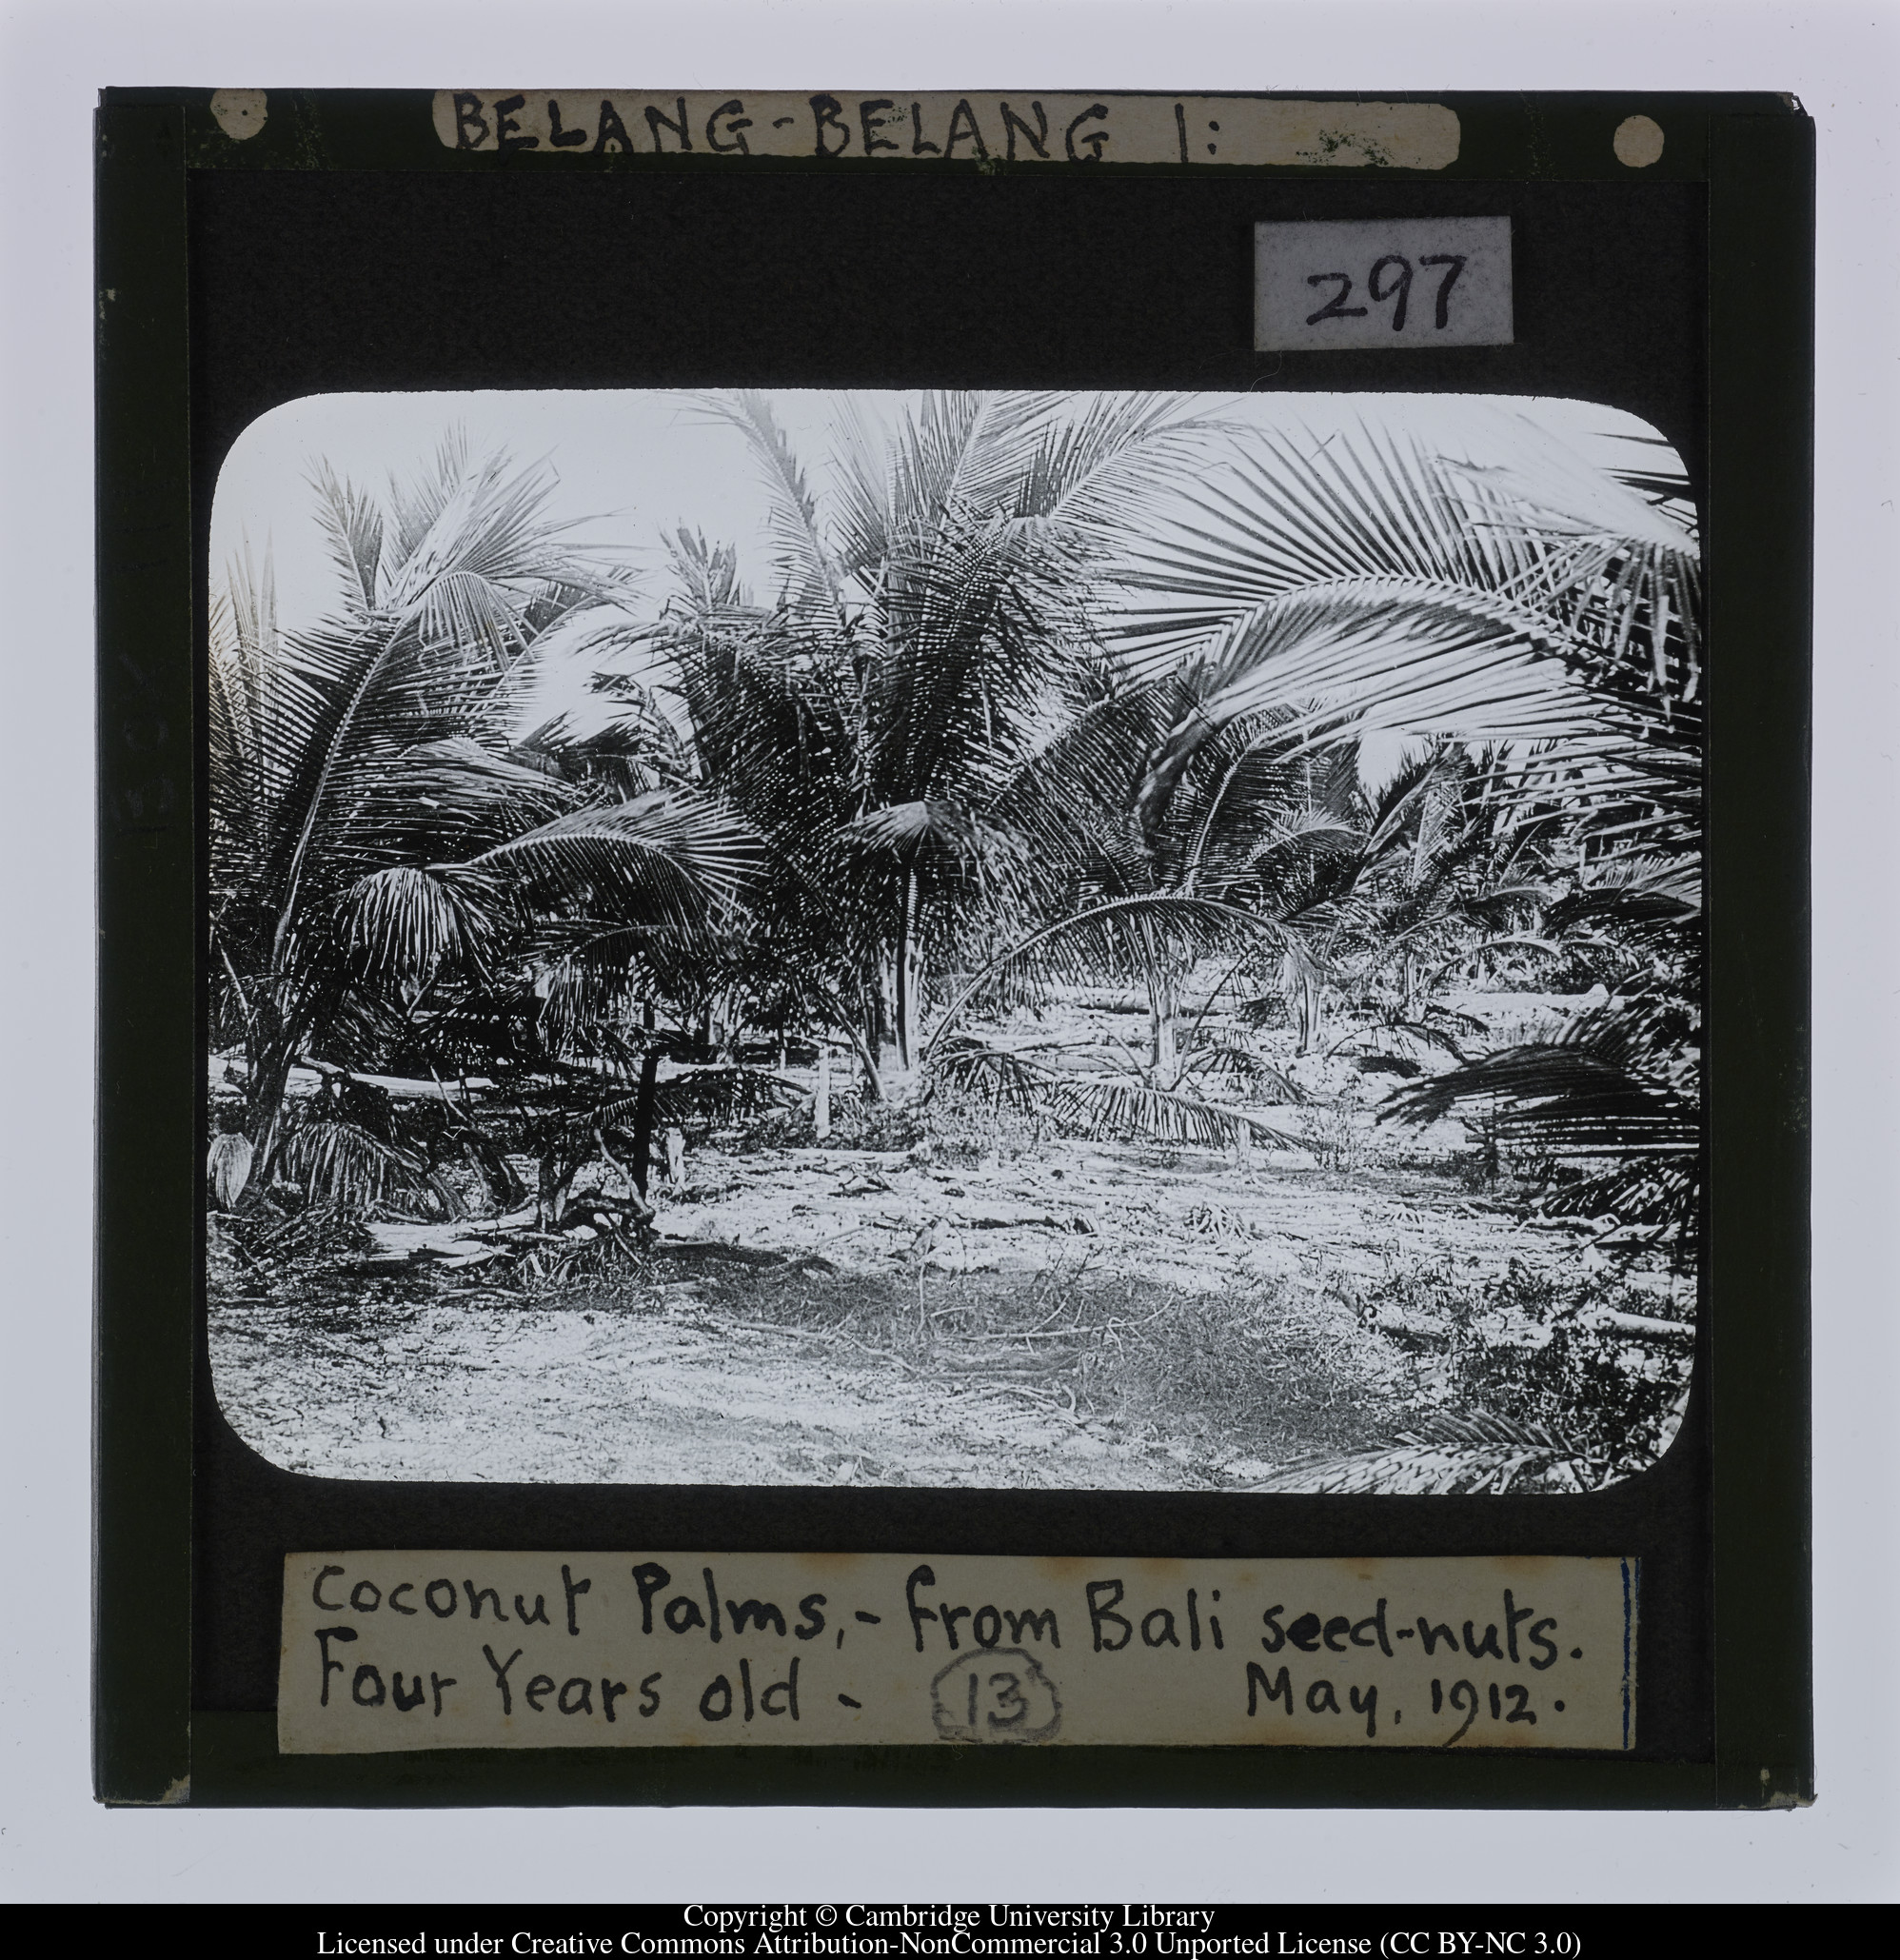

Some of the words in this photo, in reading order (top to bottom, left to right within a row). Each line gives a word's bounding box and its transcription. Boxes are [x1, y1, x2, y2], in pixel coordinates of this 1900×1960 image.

[452, 91, 1110, 167] BELANG-BELANG
[1305, 254, 1468, 331] 297
[312, 1564, 592, 1636] Coconut
[905, 1563, 1061, 1653] from
[1085, 1578, 1225, 1653] Bali
[314, 1626, 458, 1717] Four
[482, 1643, 663, 1723] Years
[699, 1656, 801, 1722] old
[967, 1672, 1030, 1728] 13
[1430, 1677, 1567, 1748] 1912.
